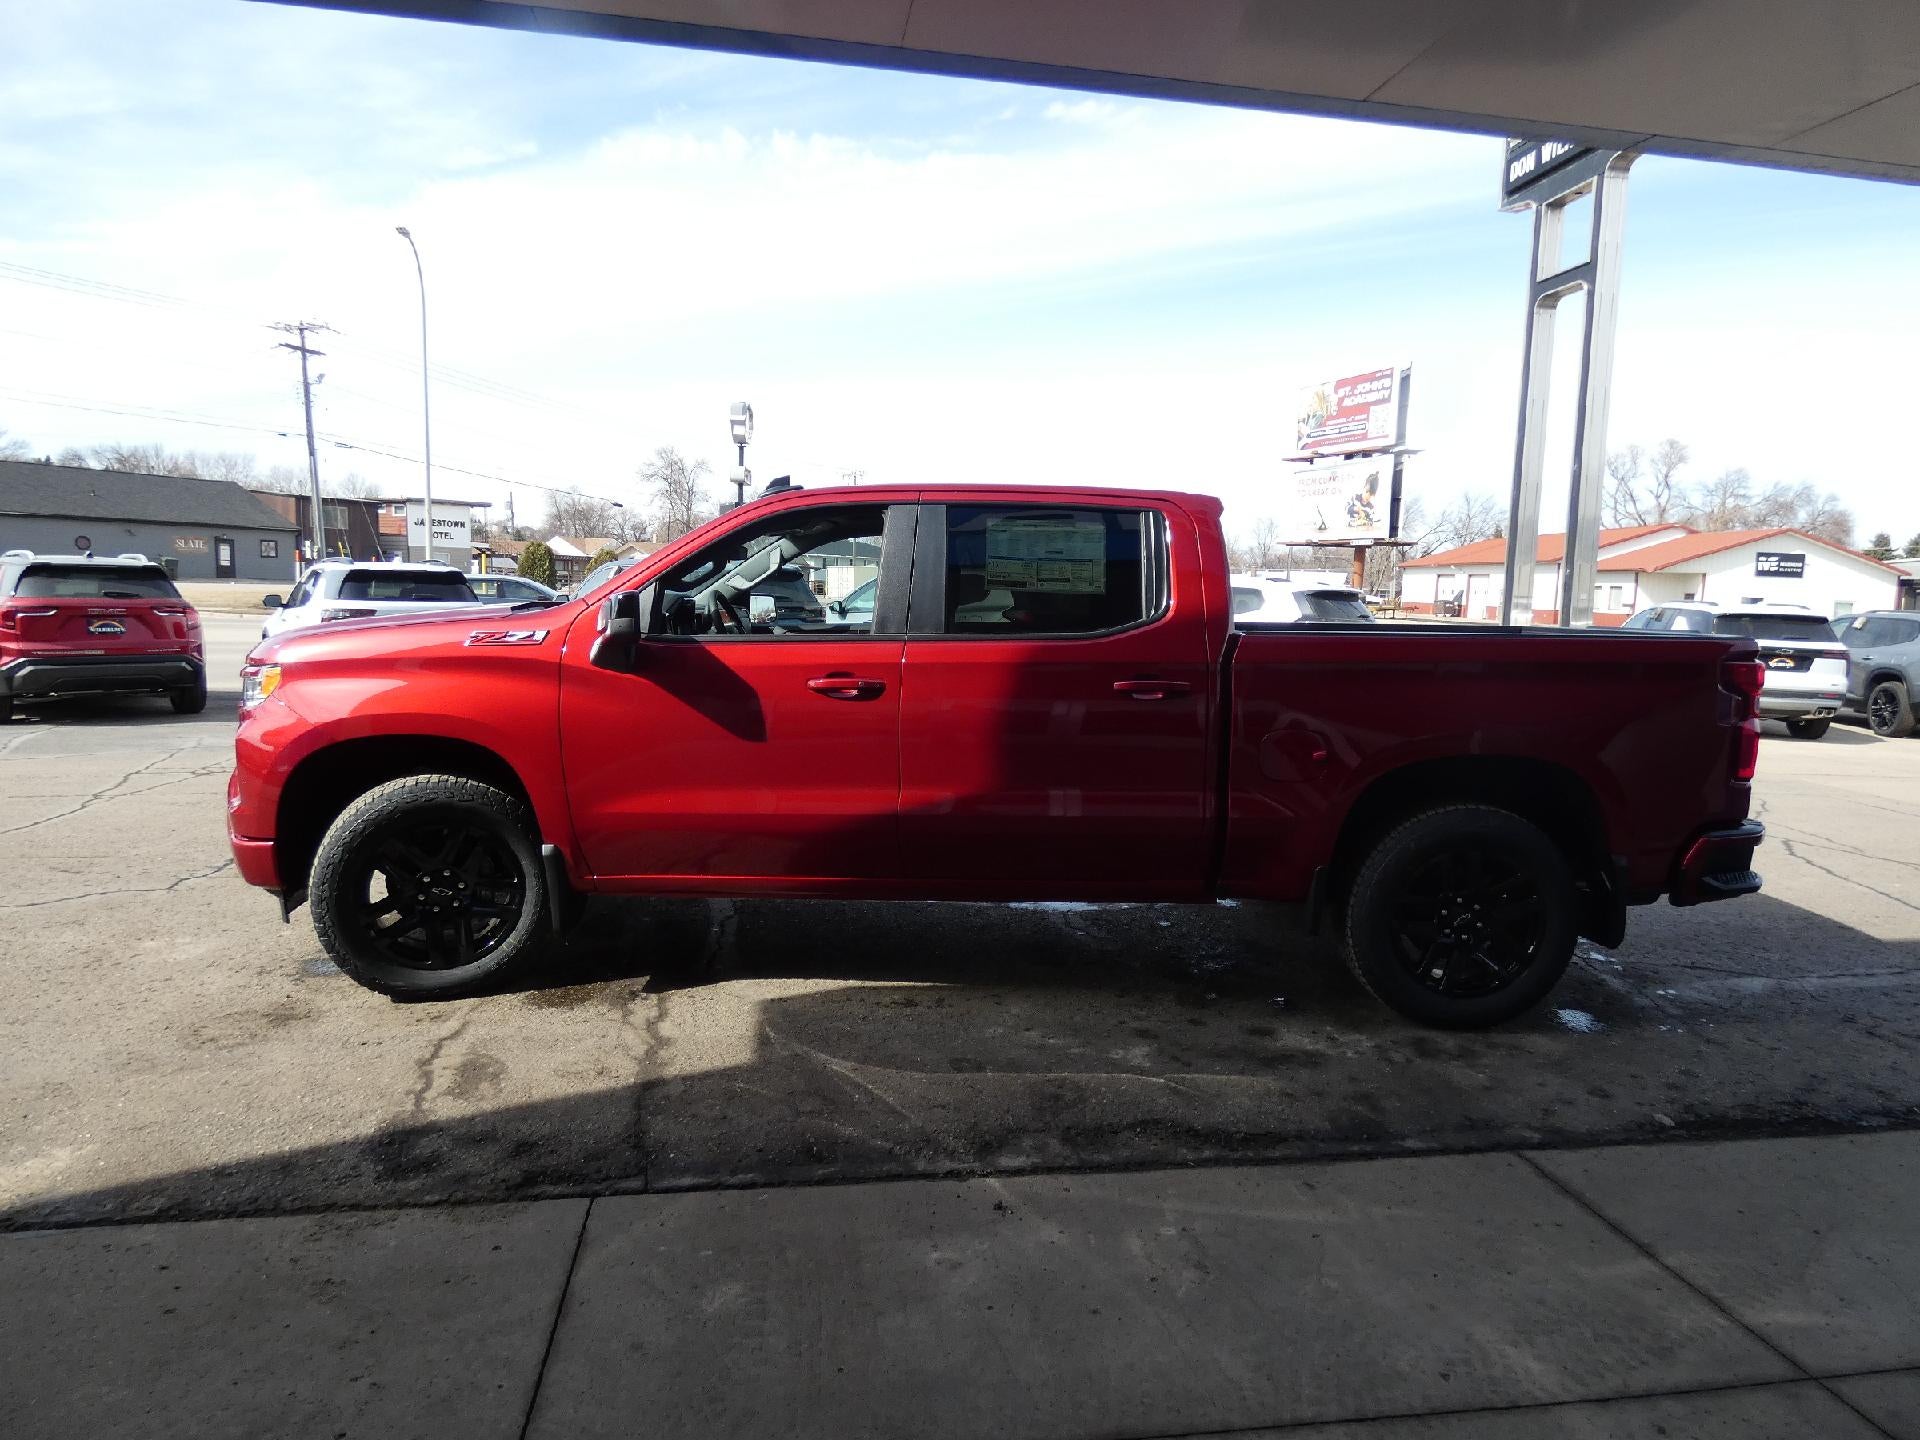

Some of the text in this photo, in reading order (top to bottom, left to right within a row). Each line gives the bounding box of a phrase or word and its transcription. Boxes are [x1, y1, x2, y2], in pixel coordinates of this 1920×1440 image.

[1509, 149, 1537, 182] DON
[413, 517, 466, 528] JAESTOWN
[432, 531, 454, 540] OTEL
[176, 539, 206, 549] SLATE
[464, 630, 550, 647] Z71
